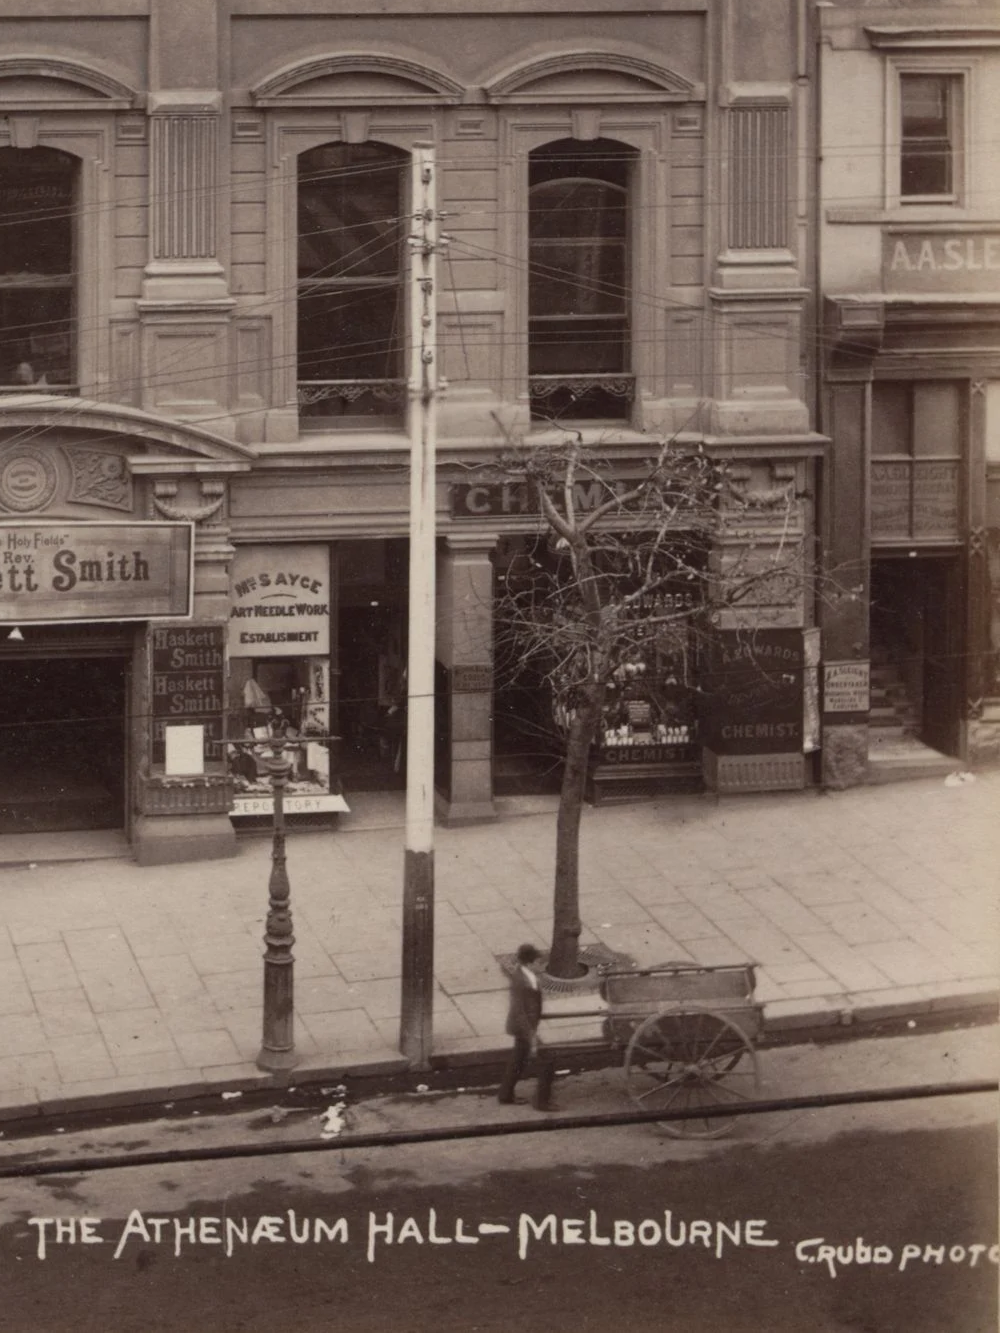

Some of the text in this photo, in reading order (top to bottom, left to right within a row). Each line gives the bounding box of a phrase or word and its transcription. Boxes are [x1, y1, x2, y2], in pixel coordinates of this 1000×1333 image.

[7, 533, 32, 550] Holy
[3, 551, 35, 564] Rev.
[51, 549, 151, 592] Smith
[155, 629, 215, 650] Haskett
[240, 631, 319, 644] ESTABLISHMENT
[170, 647, 221, 668] Smith
[154, 675, 215, 695] Haskett
[169, 693, 220, 714] Smith
